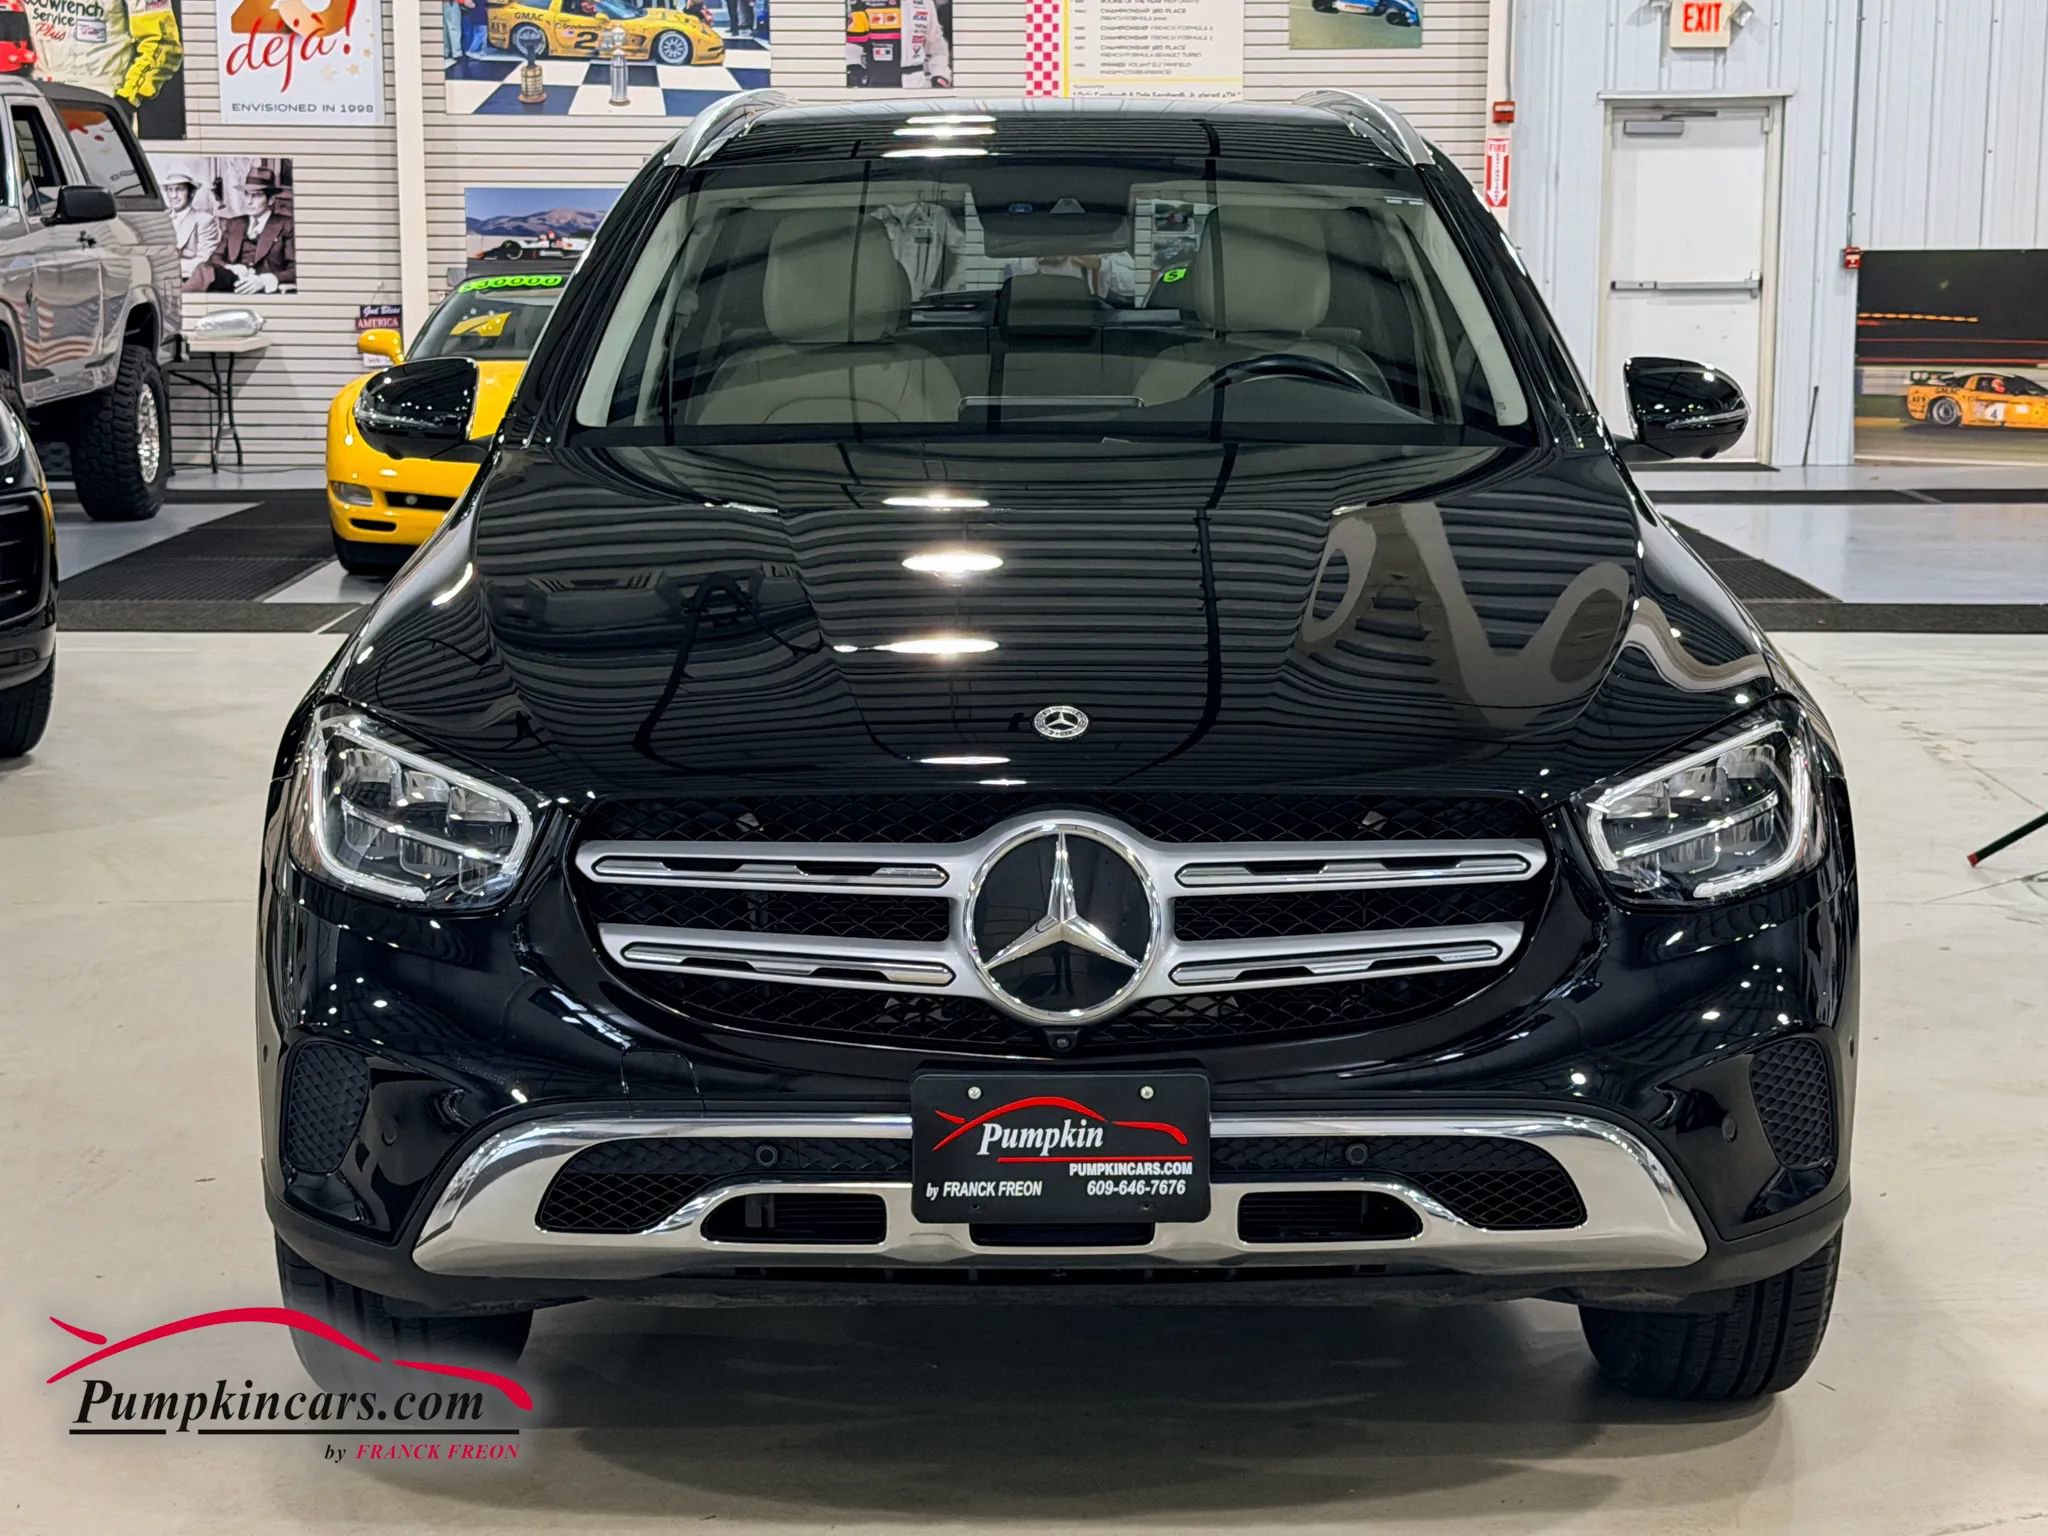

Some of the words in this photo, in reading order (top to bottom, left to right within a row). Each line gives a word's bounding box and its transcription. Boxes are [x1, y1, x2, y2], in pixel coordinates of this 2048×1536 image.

[32, 8, 75, 27] Service
[514, 12, 544, 22] GMAC
[1682, 3, 1722, 32] EXIT
[35, 23, 67, 41] Plus
[574, 31, 600, 50] 2
[232, 103, 317, 113] ENVISIONED
[322, 104, 335, 113] IN
[341, 104, 374, 113] 1998
[1488, 143, 1507, 153] FIRE
[358, 318, 399, 329] AMERICA
[1990, 409, 1998, 421] 4
[976, 1118, 1104, 1156] Pumpkin
[1069, 1161, 1193, 1176] PUMPKINCARS.COM
[925, 1182, 939, 1201] by
[942, 1181, 996, 1198] FRANCK
[998, 1180, 1043, 1197] FREON
[1086, 1179, 1186, 1196] 609-646-7676
